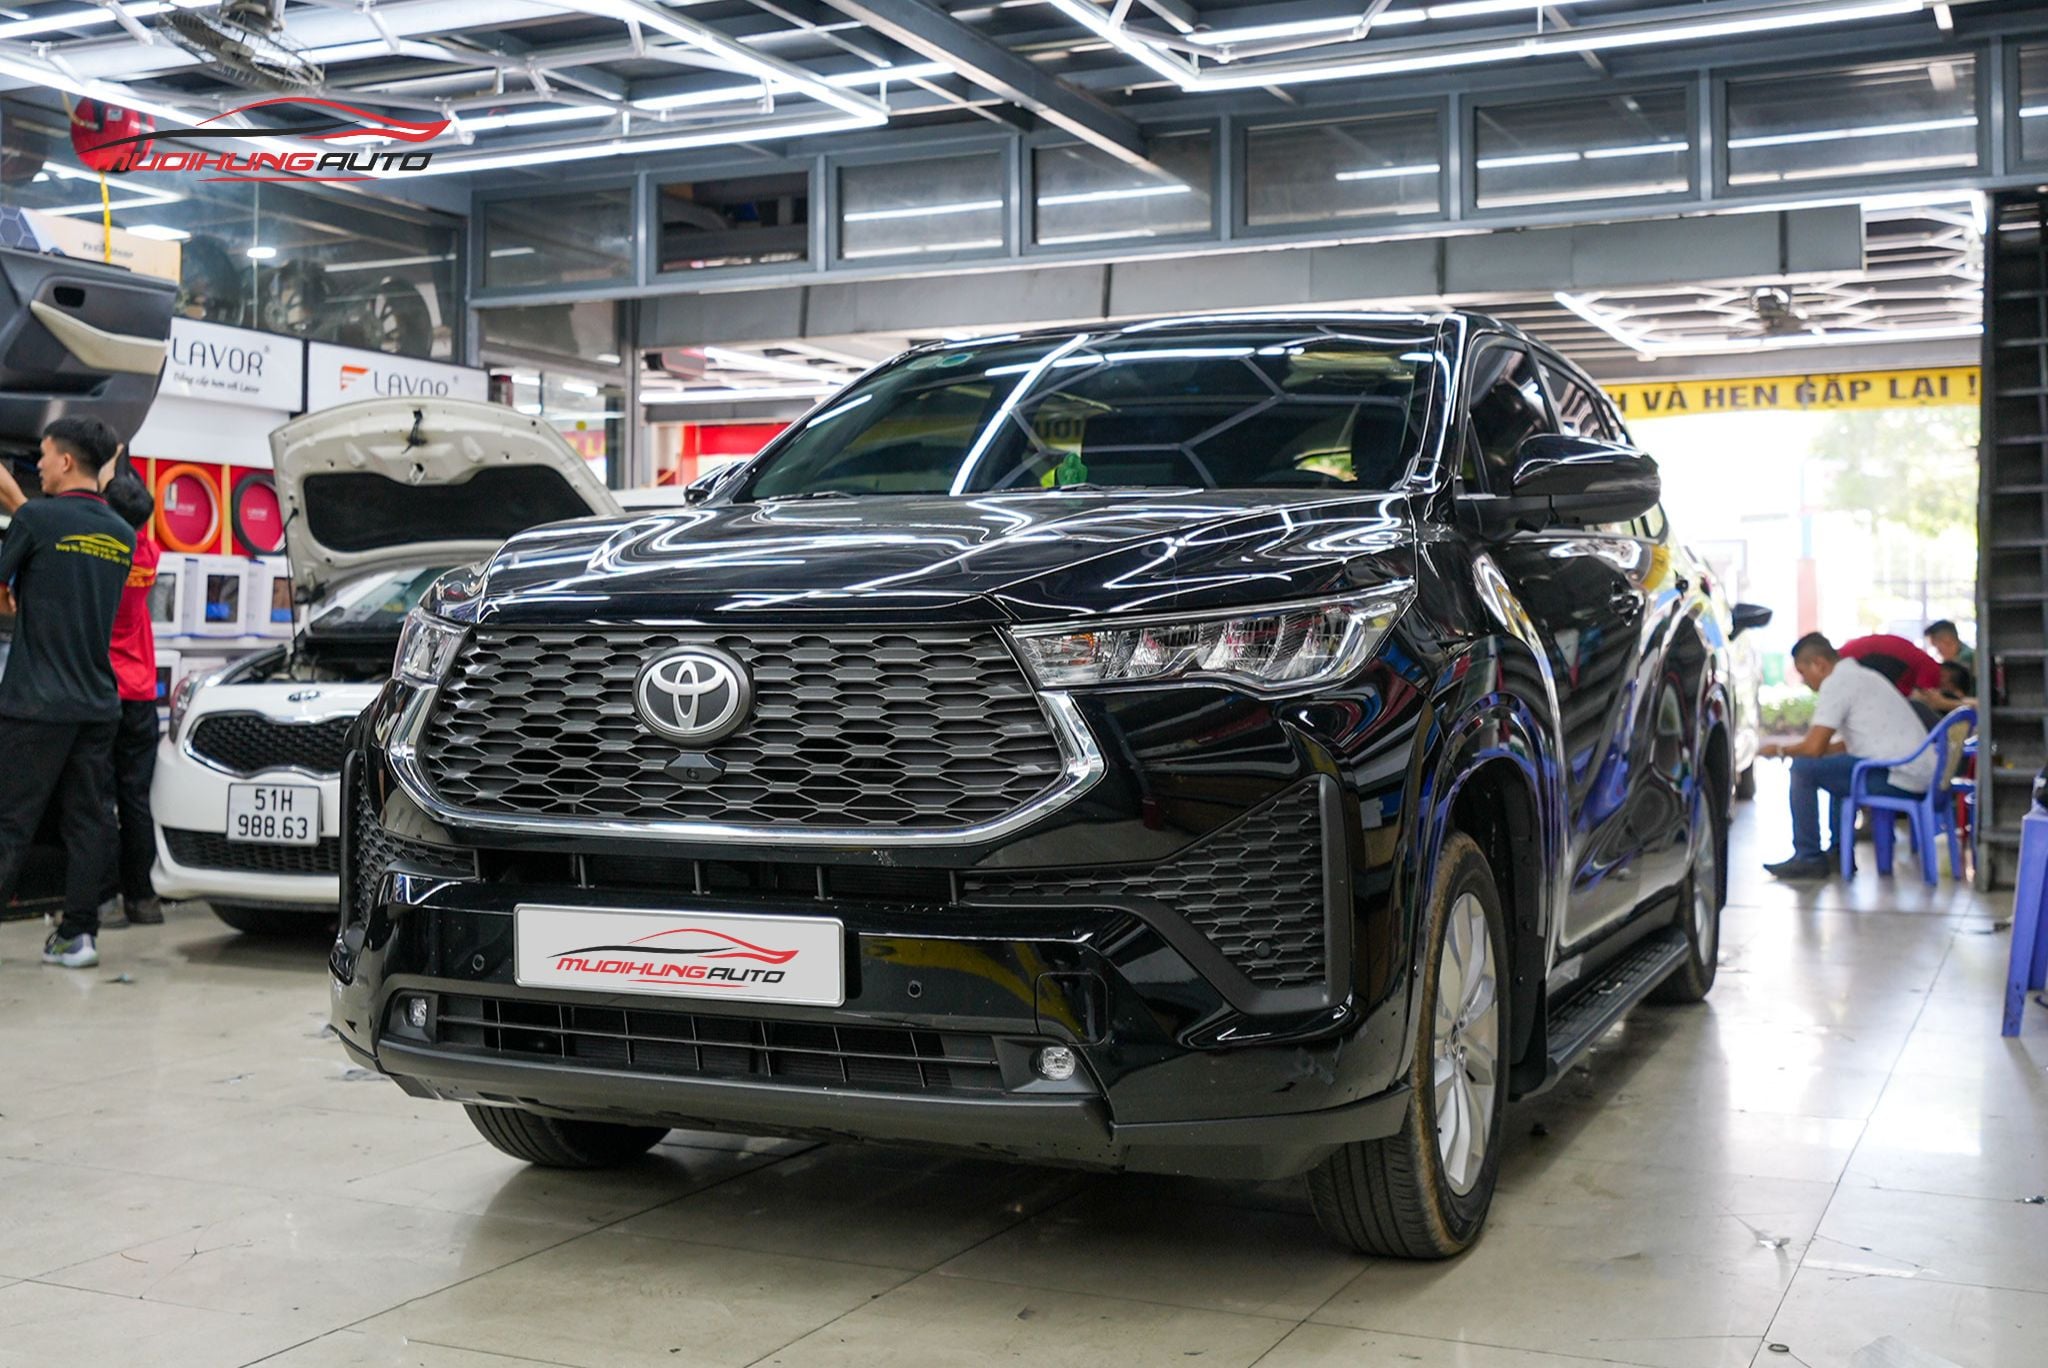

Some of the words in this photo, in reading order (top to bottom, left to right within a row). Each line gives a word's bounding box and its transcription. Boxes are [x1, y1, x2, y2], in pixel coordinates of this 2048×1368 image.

[172, 337, 264, 377] LAVOR
[254, 788, 293, 812] 51H
[238, 814, 308, 839] 988.63
